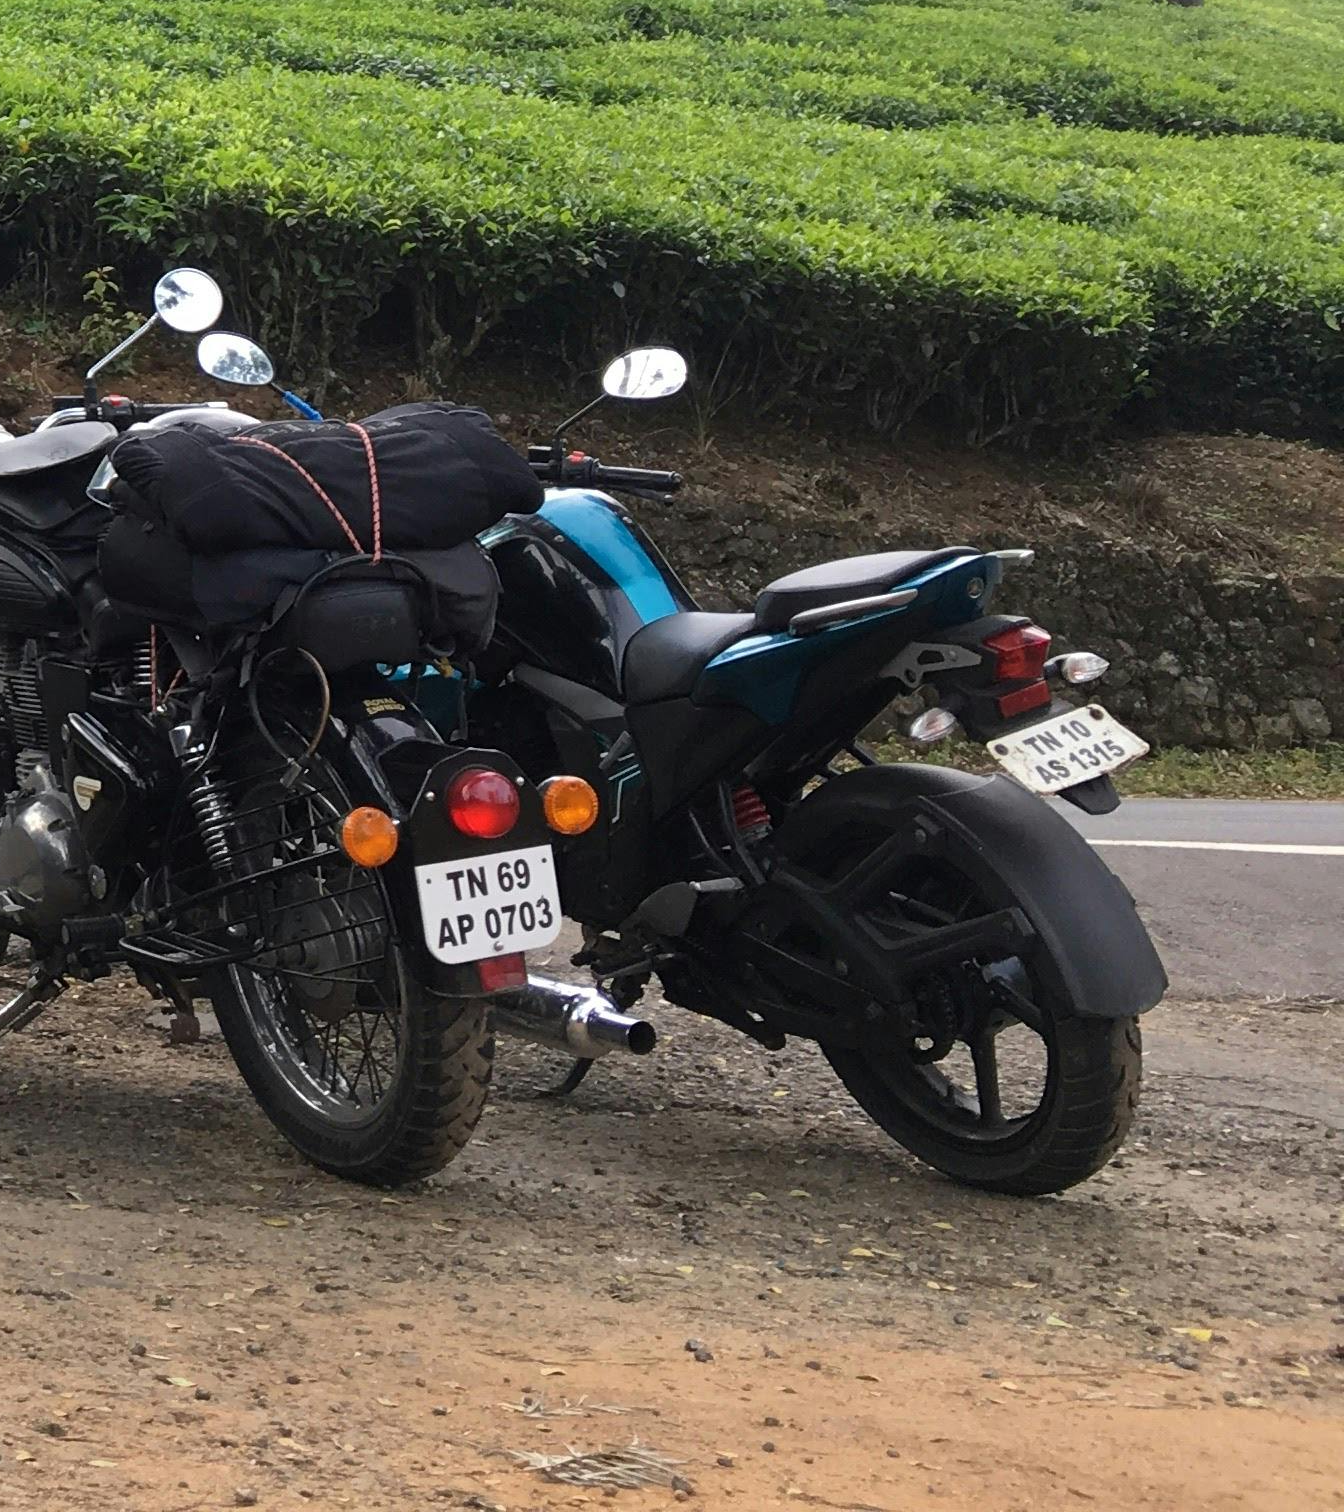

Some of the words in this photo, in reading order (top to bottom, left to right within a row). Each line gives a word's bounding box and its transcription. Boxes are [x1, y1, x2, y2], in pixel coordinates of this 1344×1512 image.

[362, 698, 397, 707] ROYAL
[1022, 730, 1063, 756] TN
[1060, 720, 1092, 742] 10
[1034, 759, 1071, 785] AS
[1069, 739, 1126, 771] 1315
[446, 865, 489, 901] TN
[497, 858, 531, 893] 69
[438, 913, 475, 949] AP
[485, 896, 554, 939] 0703
